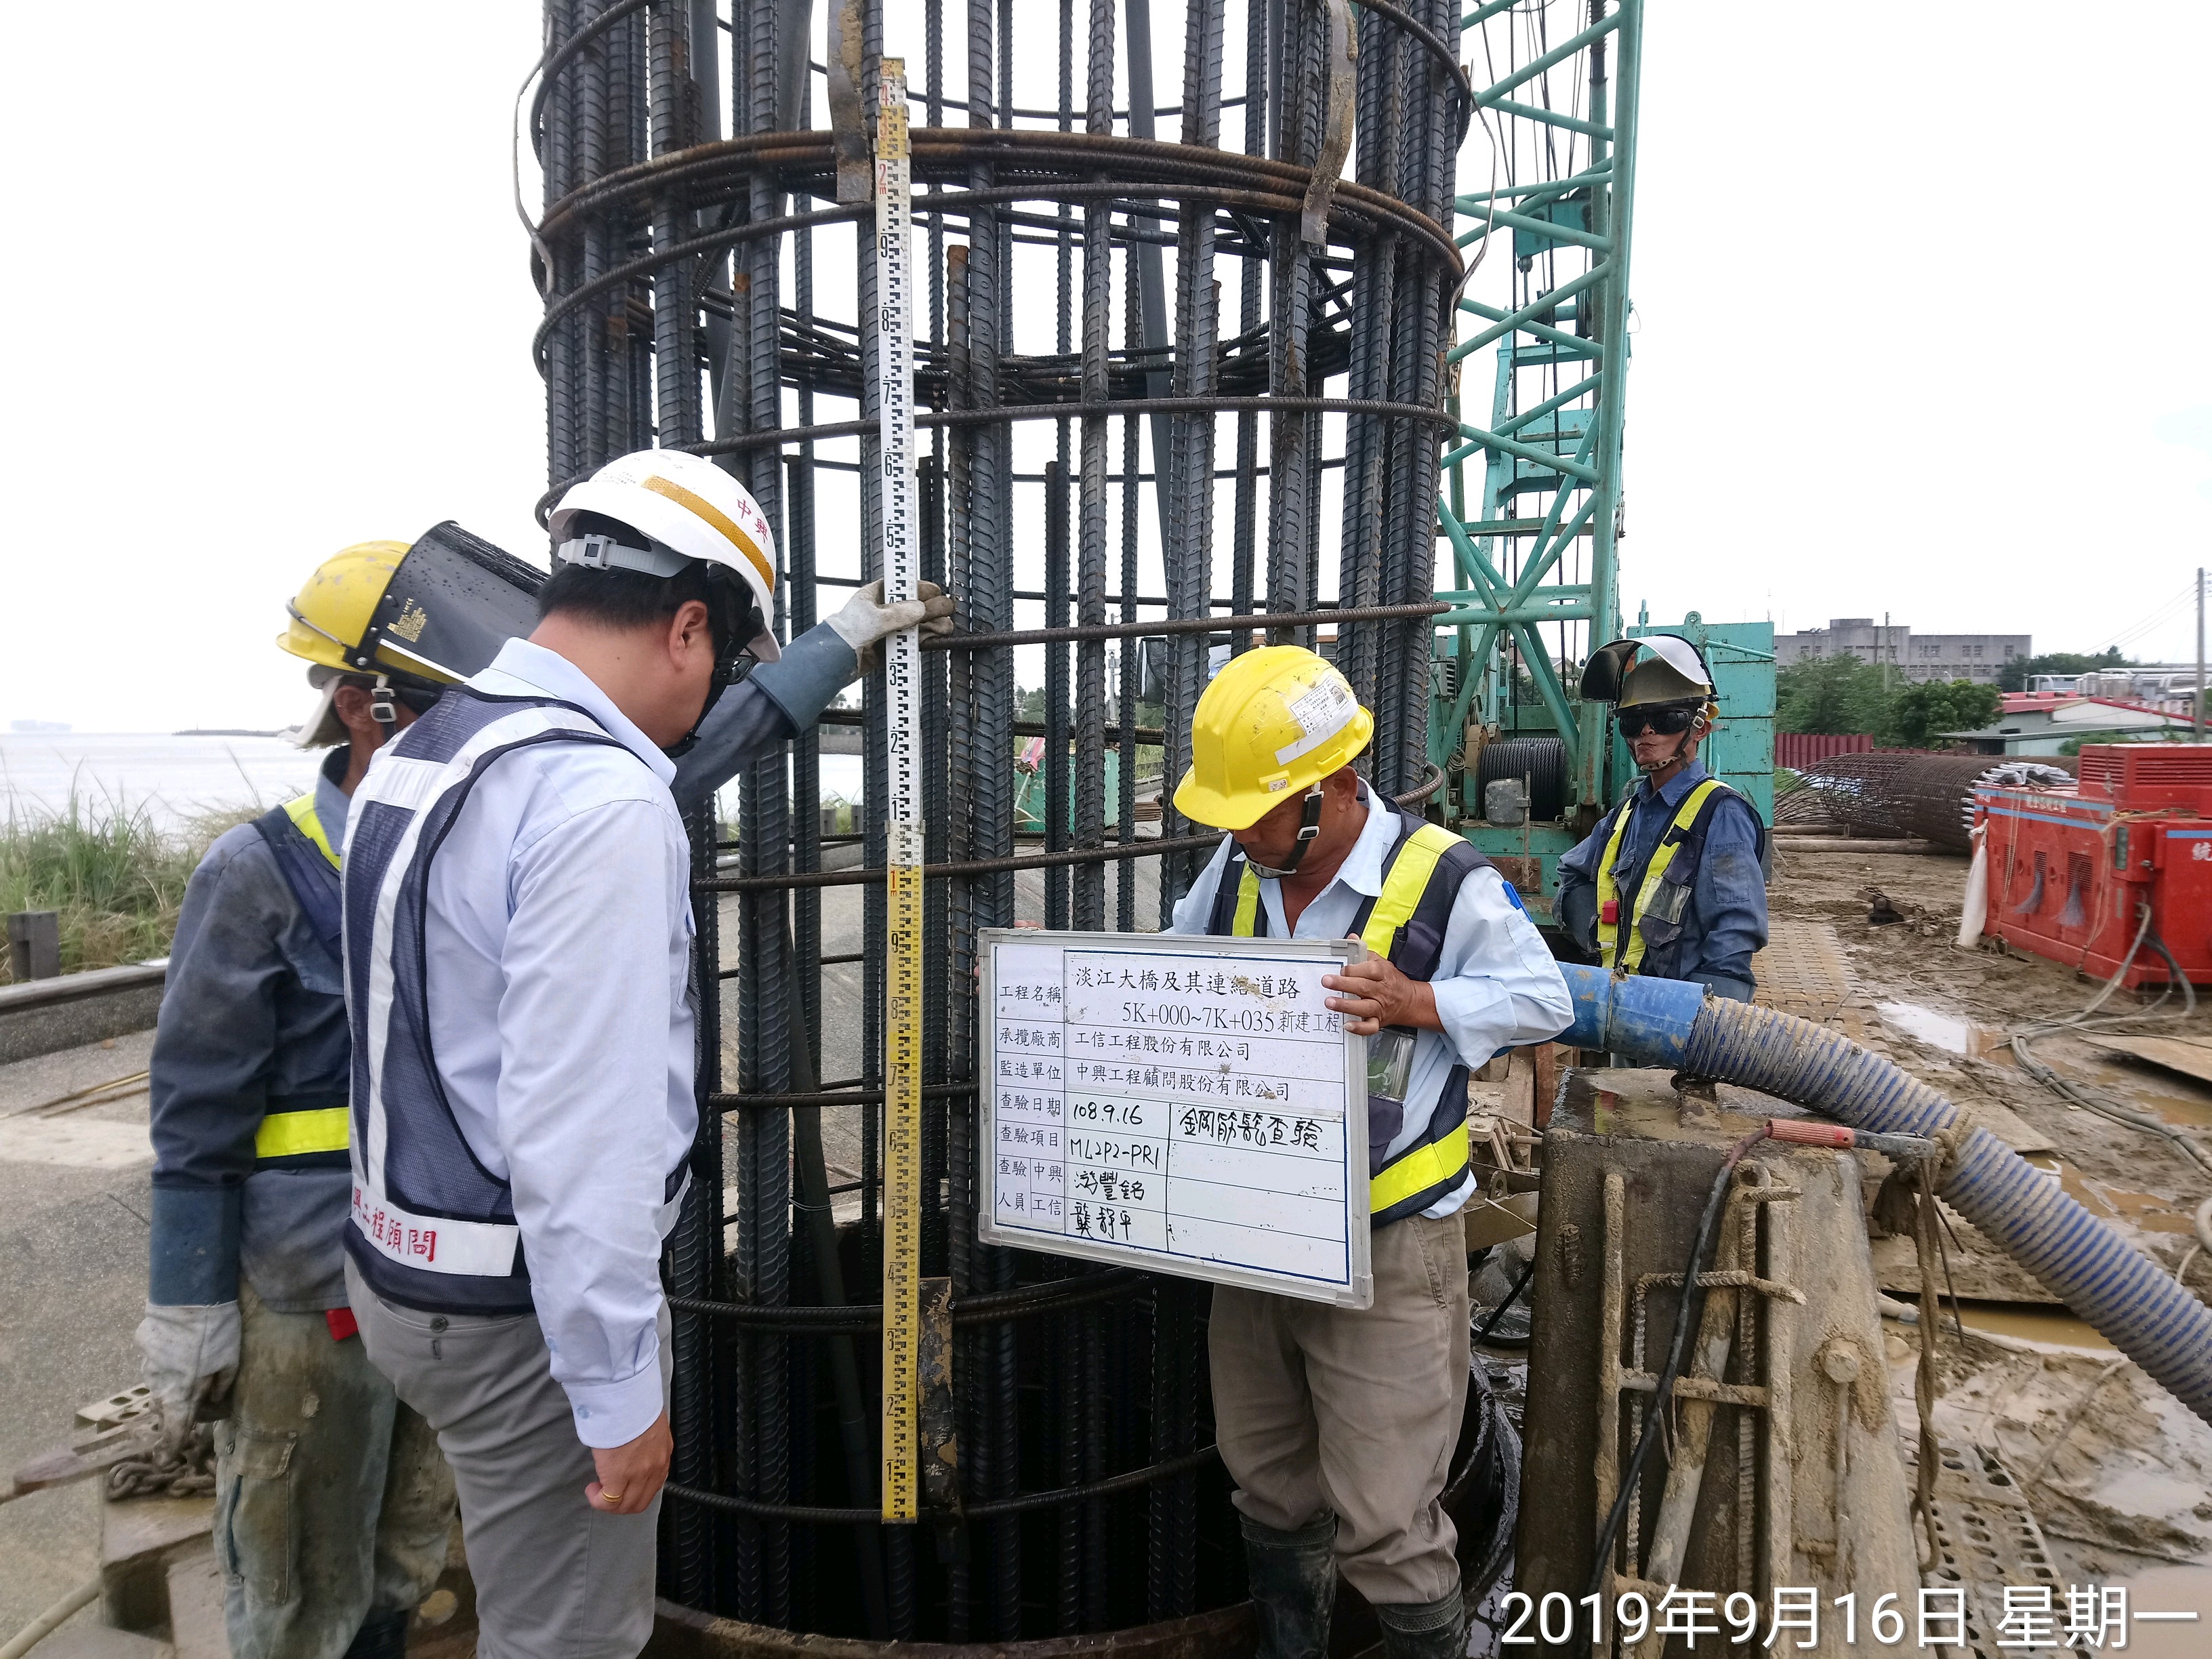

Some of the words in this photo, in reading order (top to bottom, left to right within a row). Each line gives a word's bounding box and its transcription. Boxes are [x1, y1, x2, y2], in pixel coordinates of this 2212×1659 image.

[880, 235, 888, 258] 9
[882, 309, 889, 331] 8
[882, 382, 890, 404] 7
[884, 455, 893, 476] 6
[737, 499, 768, 544] 中興
[886, 527, 894, 548] 5
[889, 665, 897, 686] 3
[890, 733, 898, 753] 2
[891, 800, 897, 820] 1
[891, 933, 899, 954] 9
[999, 985, 1062, 1003] 工程名稱
[999, 1027, 1061, 1048] 承攬廠商
[1075, 1031, 1249, 1061] 工信工程股份有限公司
[1000, 1060, 1061, 1080] 監造單位
[1076, 1062, 1289, 1101] 中興工程顧問股份有限公司
[1000, 1092, 1061, 1115] 查驗日期
[1073, 1104, 1143, 1124] 108.9.16
[1000, 1124, 1058, 1147] 查驗項目
[998, 1157, 1027, 1177] 查驗
[1034, 1162, 1063, 1183] 中興
[998, 1192, 1025, 1211] 人員
[1032, 1198, 1062, 1216] 工信
[886, 1396, 894, 1416] 2
